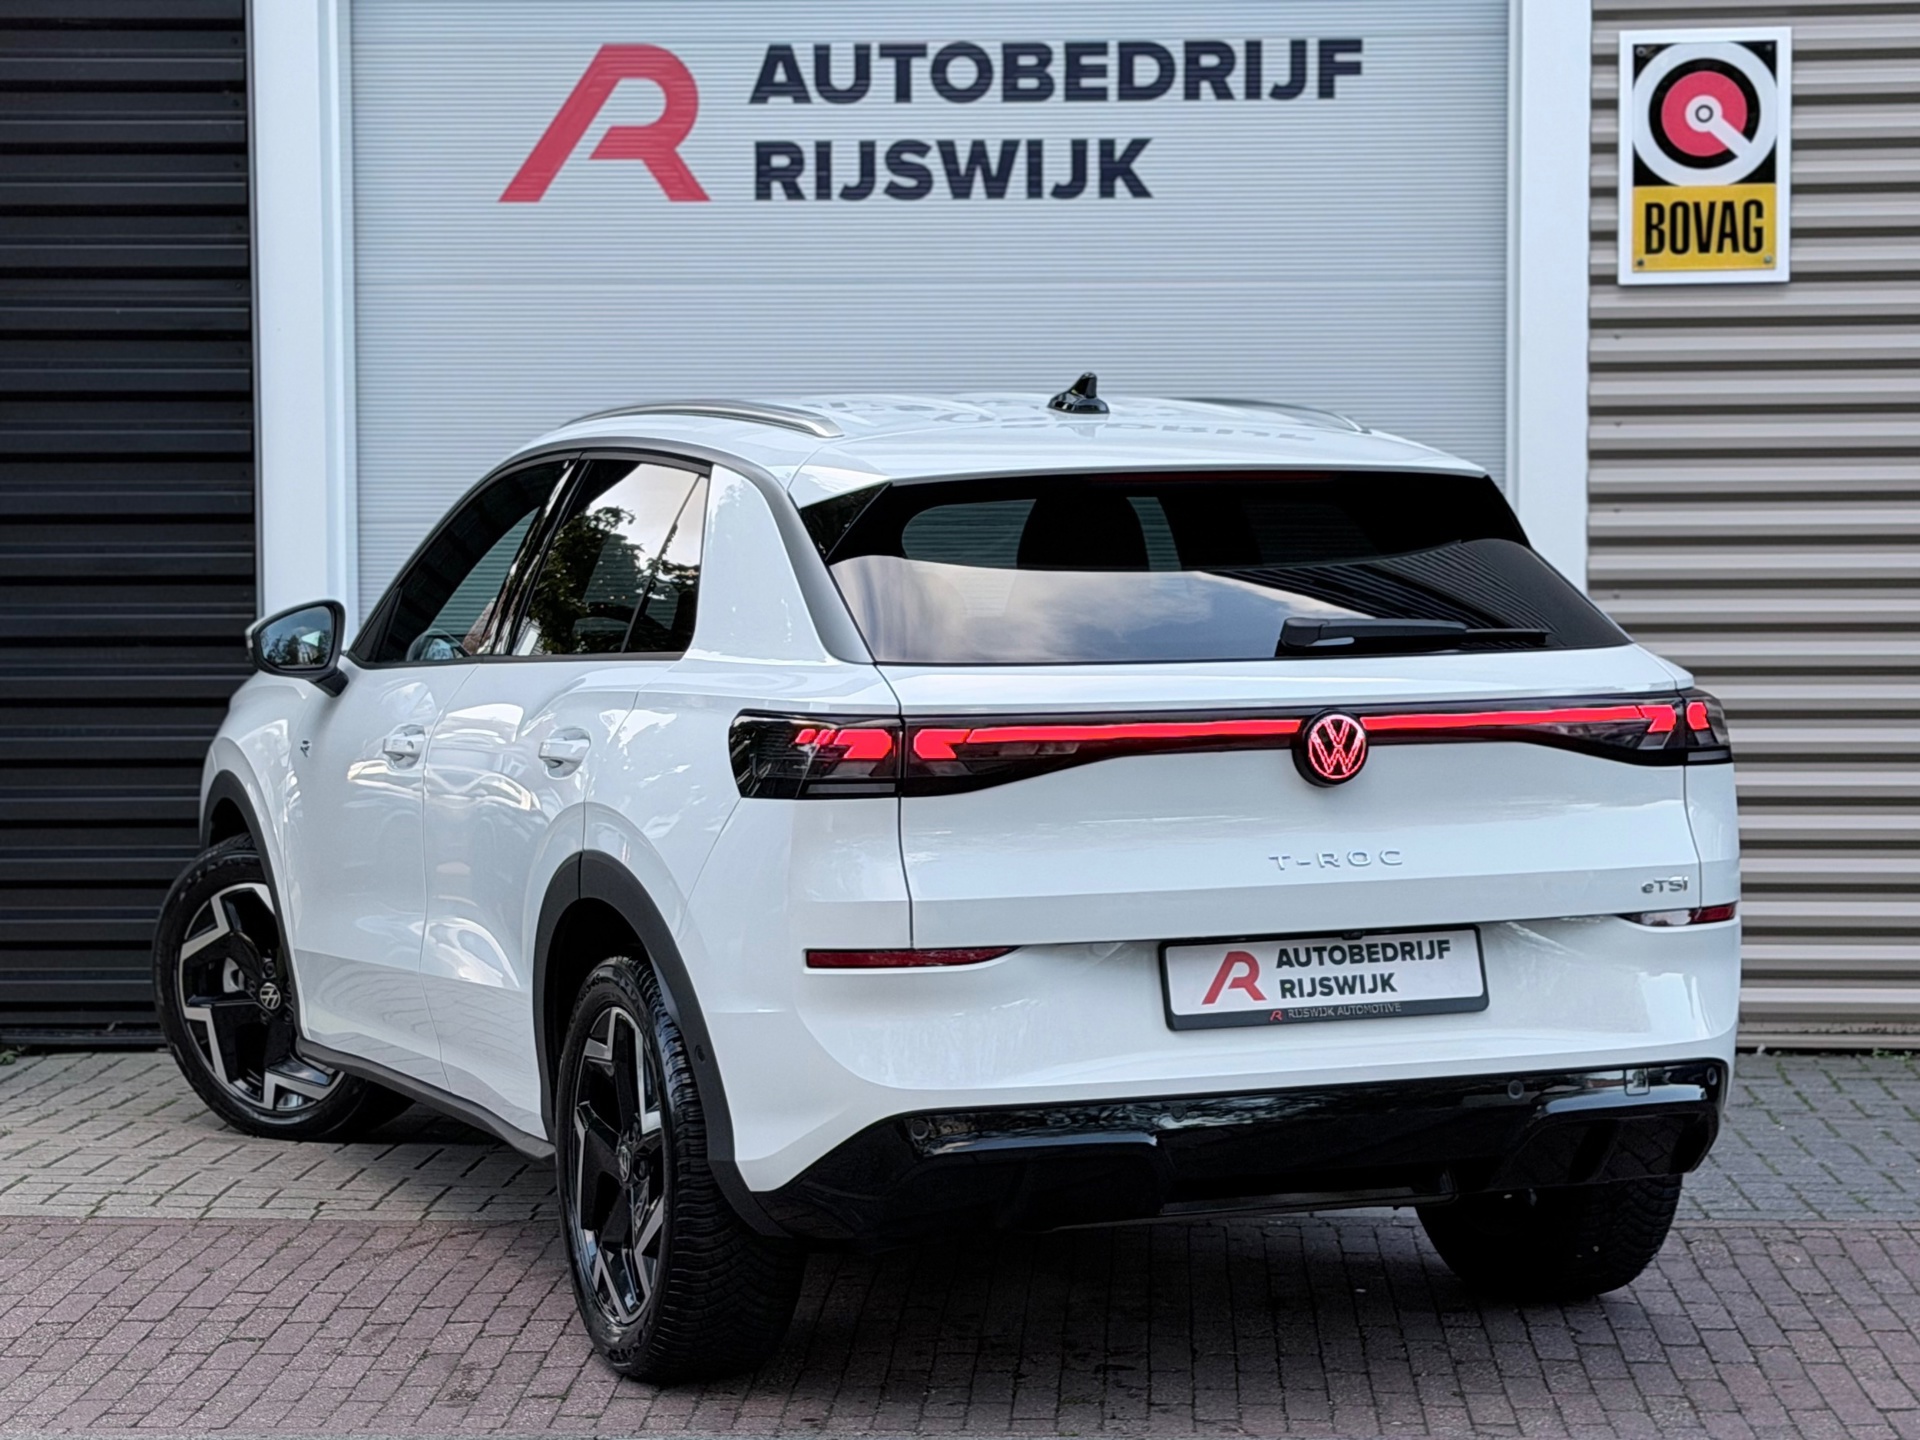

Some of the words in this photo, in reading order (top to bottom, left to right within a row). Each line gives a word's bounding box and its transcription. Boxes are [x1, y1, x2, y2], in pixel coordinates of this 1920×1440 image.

[748, 38, 1364, 104] AUTOBEDRIJF
[754, 138, 1154, 202] RIJSWIJK
[1644, 199, 1764, 255] BOVAG
[1268, 849, 1404, 872] T-ROC
[1275, 939, 1451, 969] AUTOBEDRIJF
[1279, 972, 1398, 1000] RIJSWIJK
[1287, 1007, 1335, 1019] RIJSWIJK
[1336, 1002, 1403, 1017] AUTOMOTIVE
